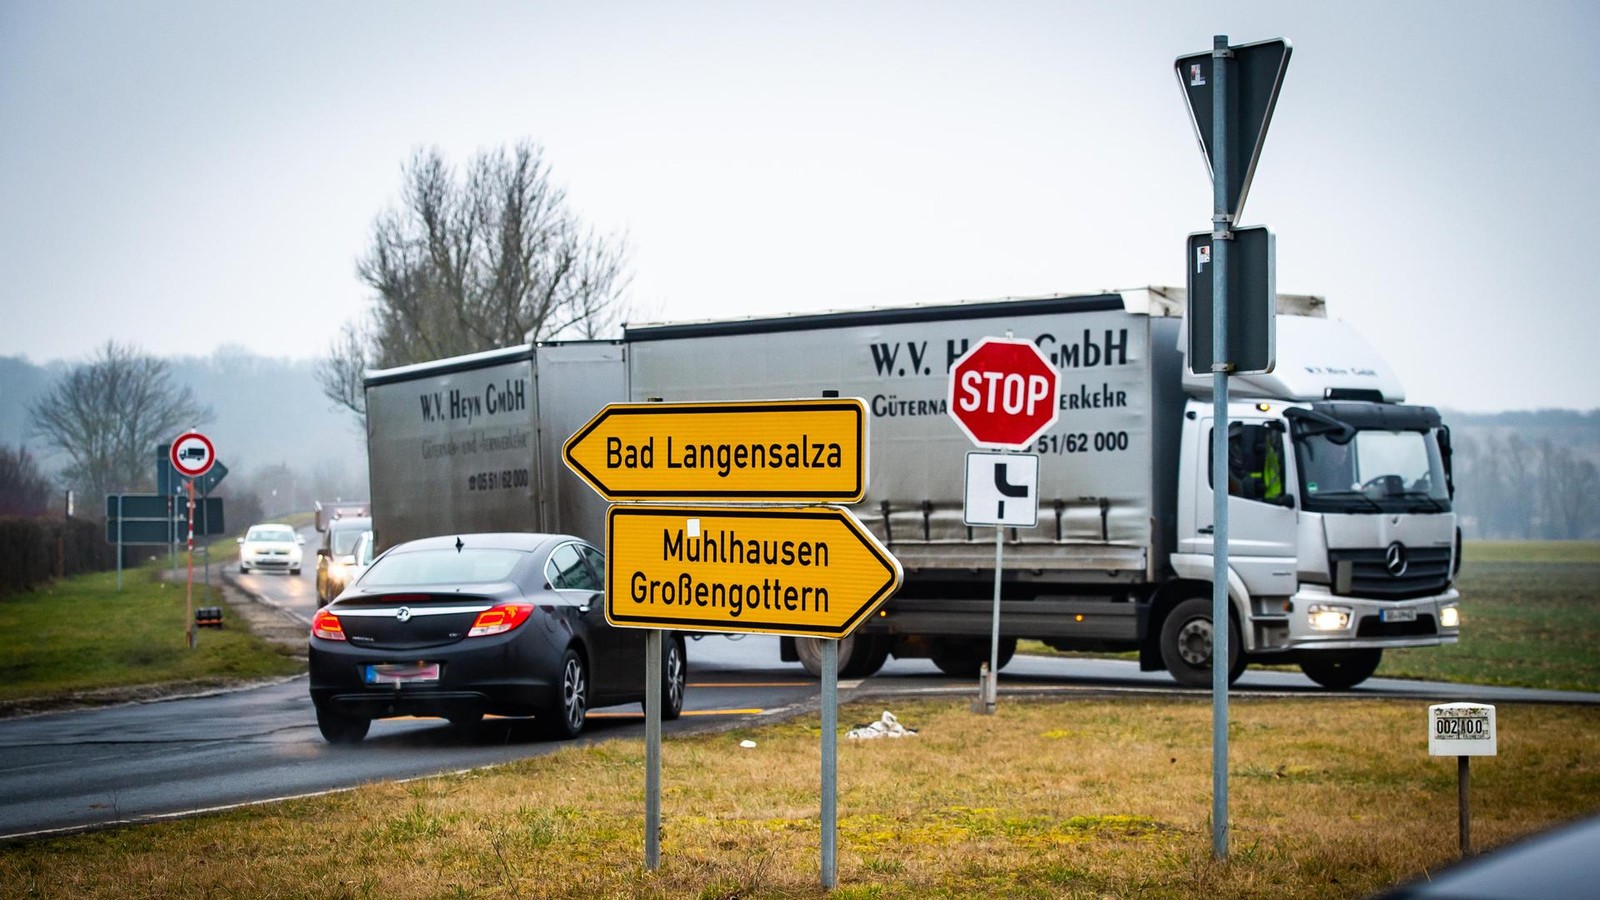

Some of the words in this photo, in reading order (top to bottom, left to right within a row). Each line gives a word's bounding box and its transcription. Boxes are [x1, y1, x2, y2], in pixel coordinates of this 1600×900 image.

[870, 341, 931, 377] W.V.
[959, 370, 1049, 416] STOP
[606, 437, 654, 469] Bad
[667, 434, 842, 477] Langensalza
[1094, 431, 1128, 451] 000
[631, 571, 829, 617] Großengottern
[1437, 720, 1457, 734] 002
